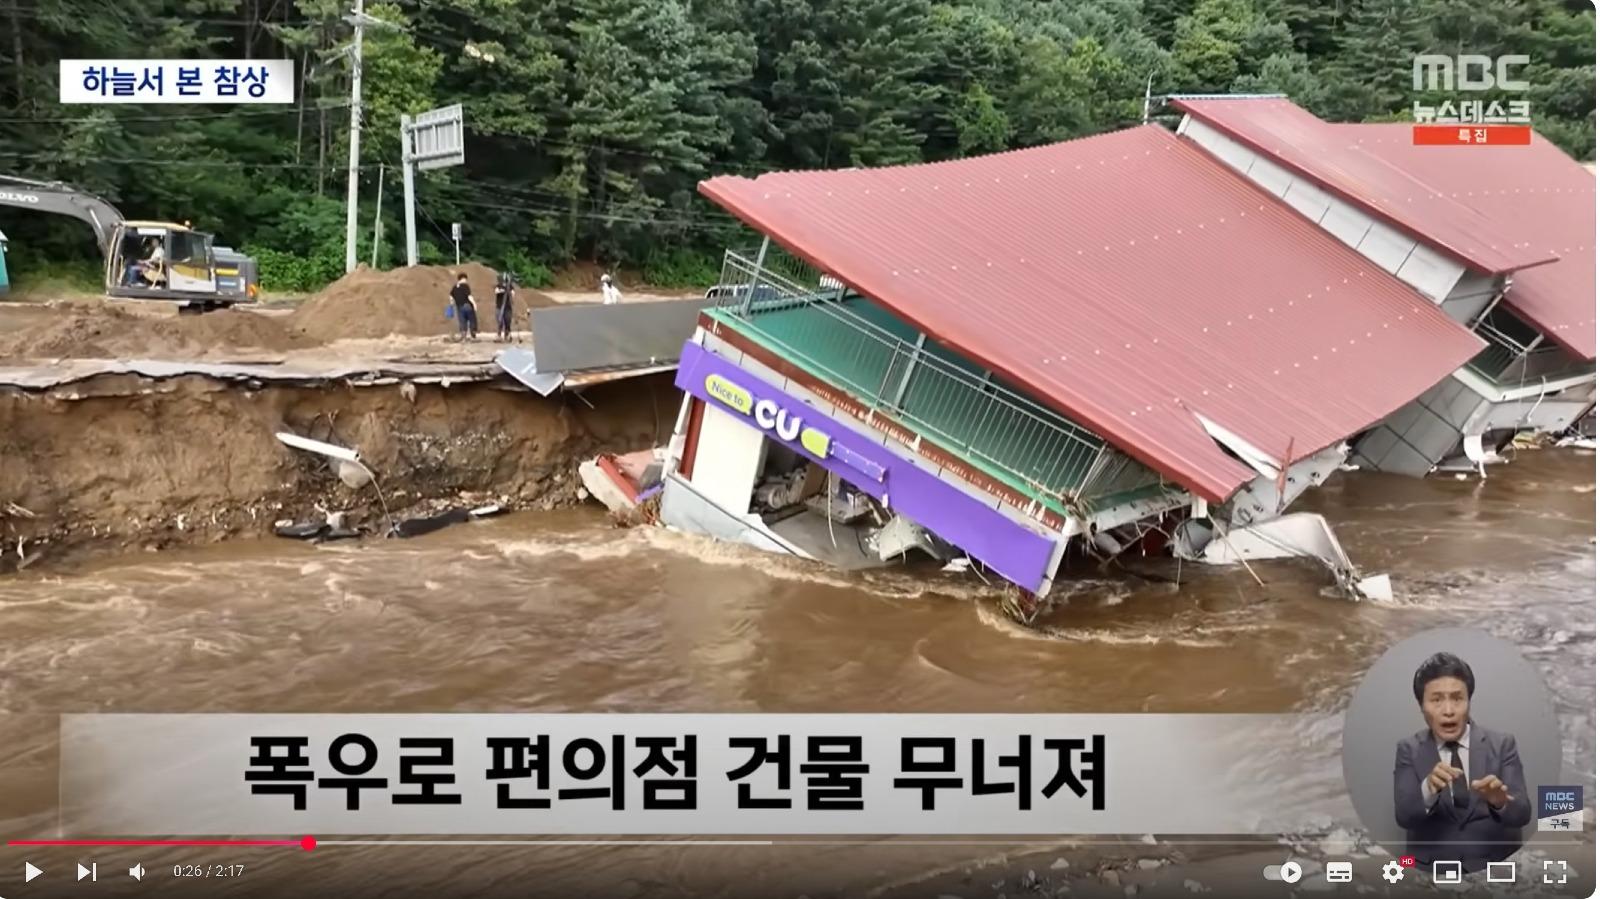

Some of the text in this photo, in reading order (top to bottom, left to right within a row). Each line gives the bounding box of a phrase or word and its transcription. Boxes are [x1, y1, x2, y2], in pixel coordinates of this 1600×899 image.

[711, 381, 744, 406] Nice to
[755, 399, 801, 441] CU
